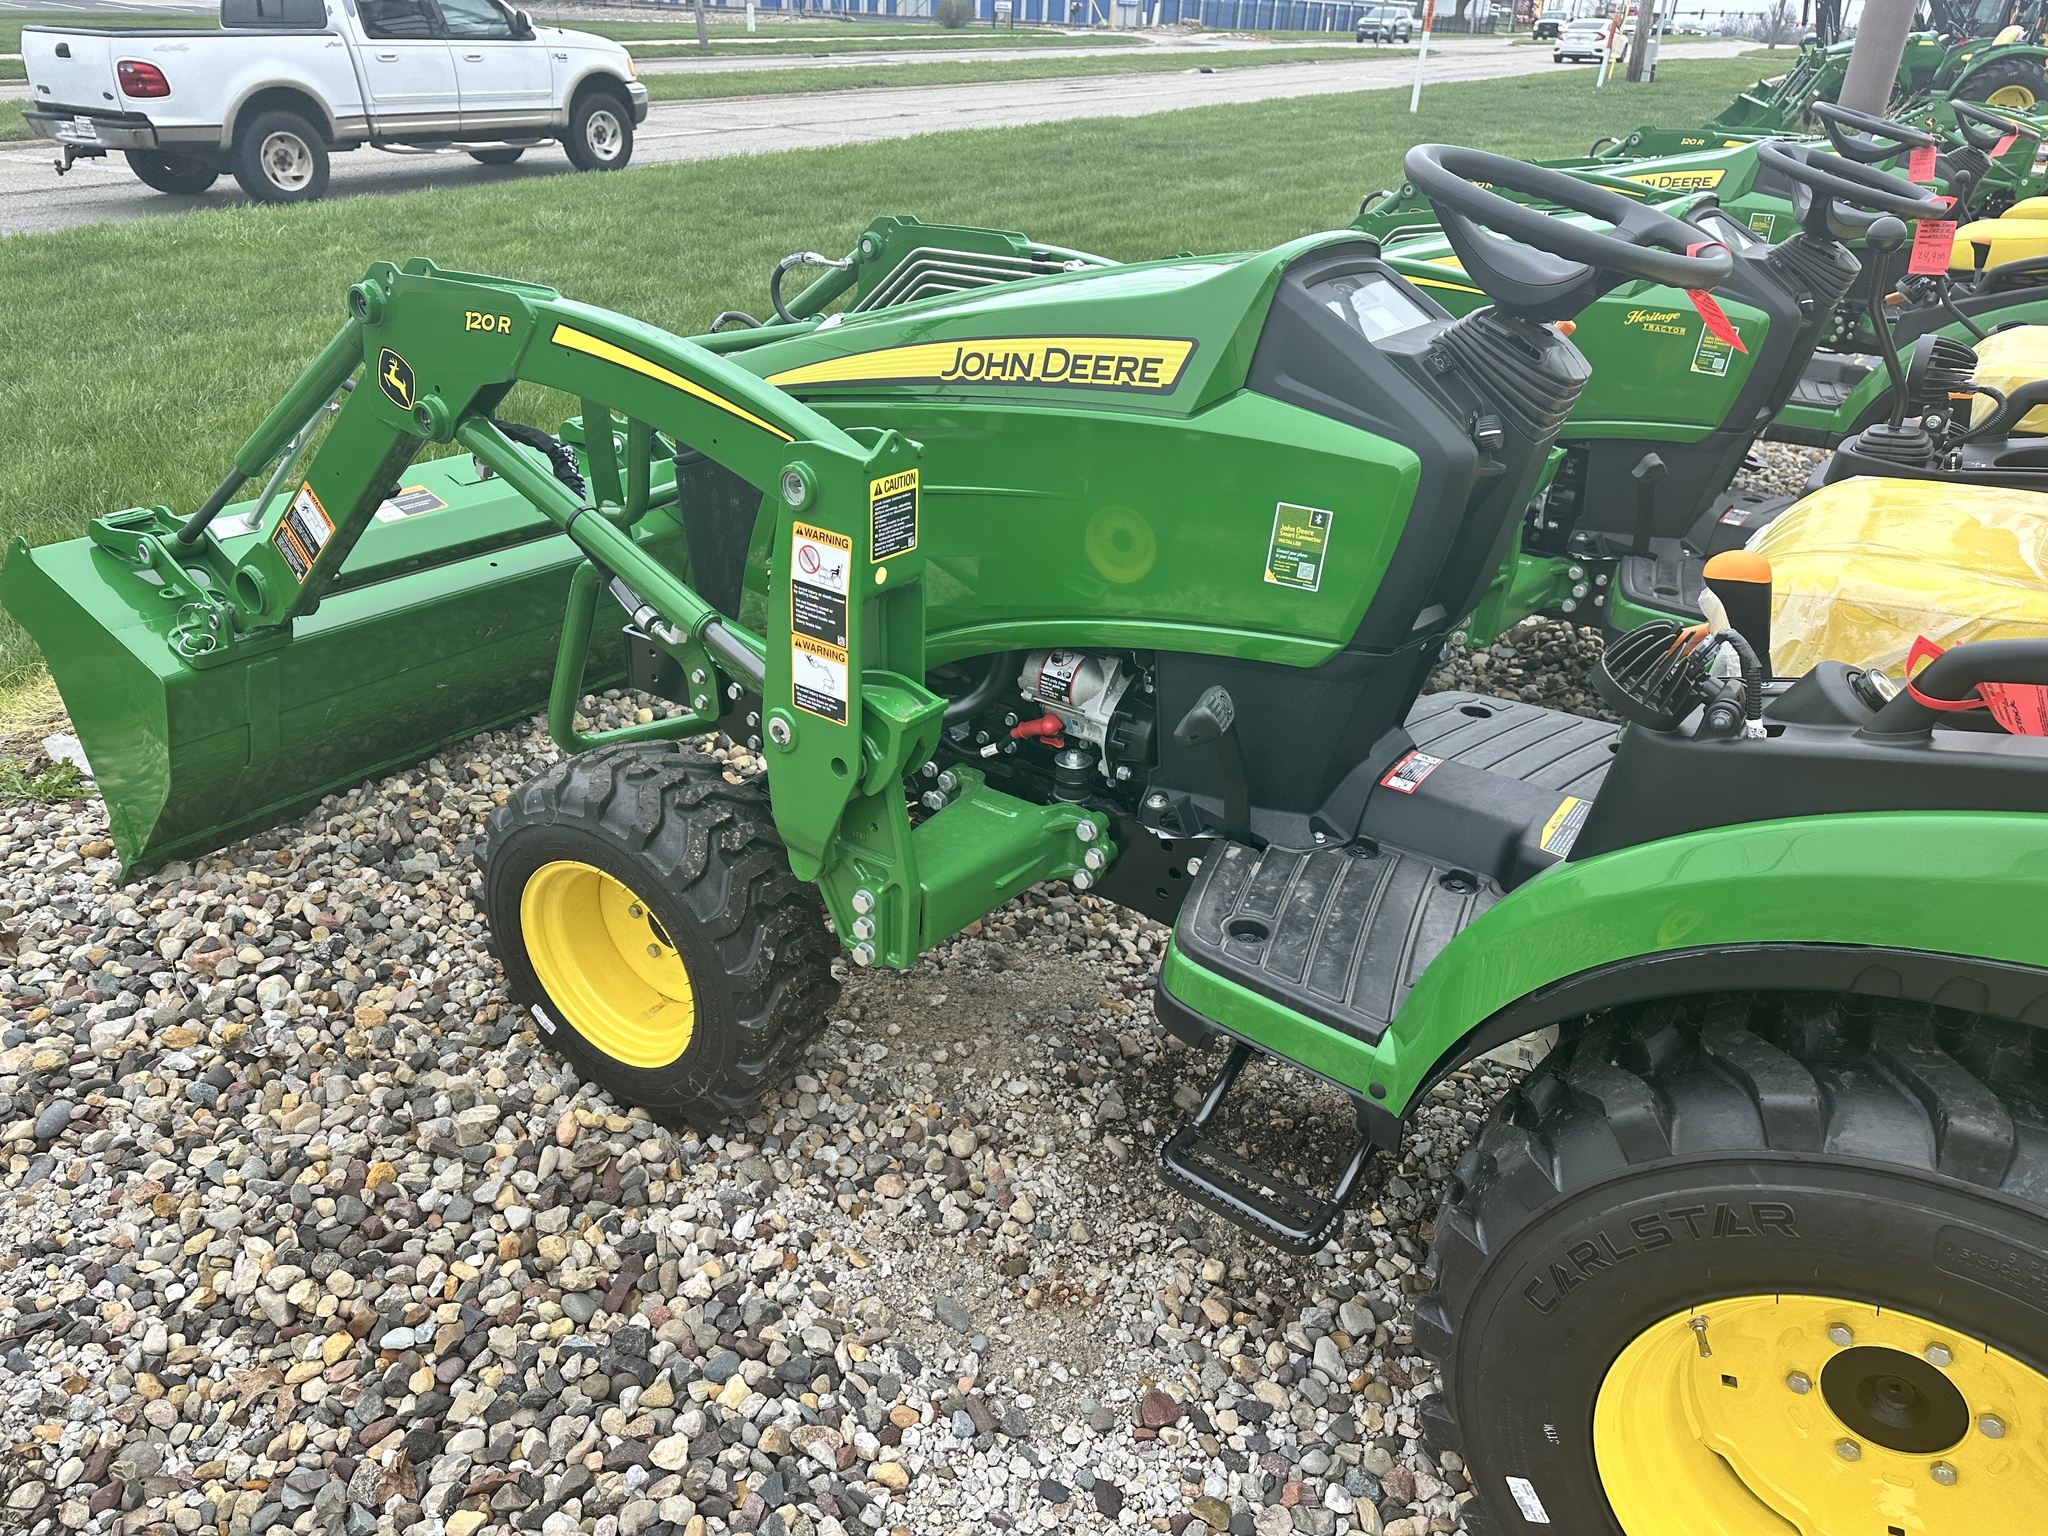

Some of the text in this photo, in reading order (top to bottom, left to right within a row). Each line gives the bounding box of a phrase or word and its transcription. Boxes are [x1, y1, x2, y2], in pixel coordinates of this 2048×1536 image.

[1658, 176, 1712, 188] DEERE
[465, 311, 512, 335] 120R
[1624, 310, 1681, 326] Heritage
[1642, 324, 1686, 335] TRACTOR
[941, 347, 1164, 384] JOHN DEERE
[884, 472, 916, 493] CAUTION
[311, 494, 332, 528] WARNING
[804, 527, 848, 549] WARNING
[1280, 524, 1314, 536] John Deere
[802, 640, 846, 662] WARNING
[1522, 1201, 1801, 1315] CARLSTAR
